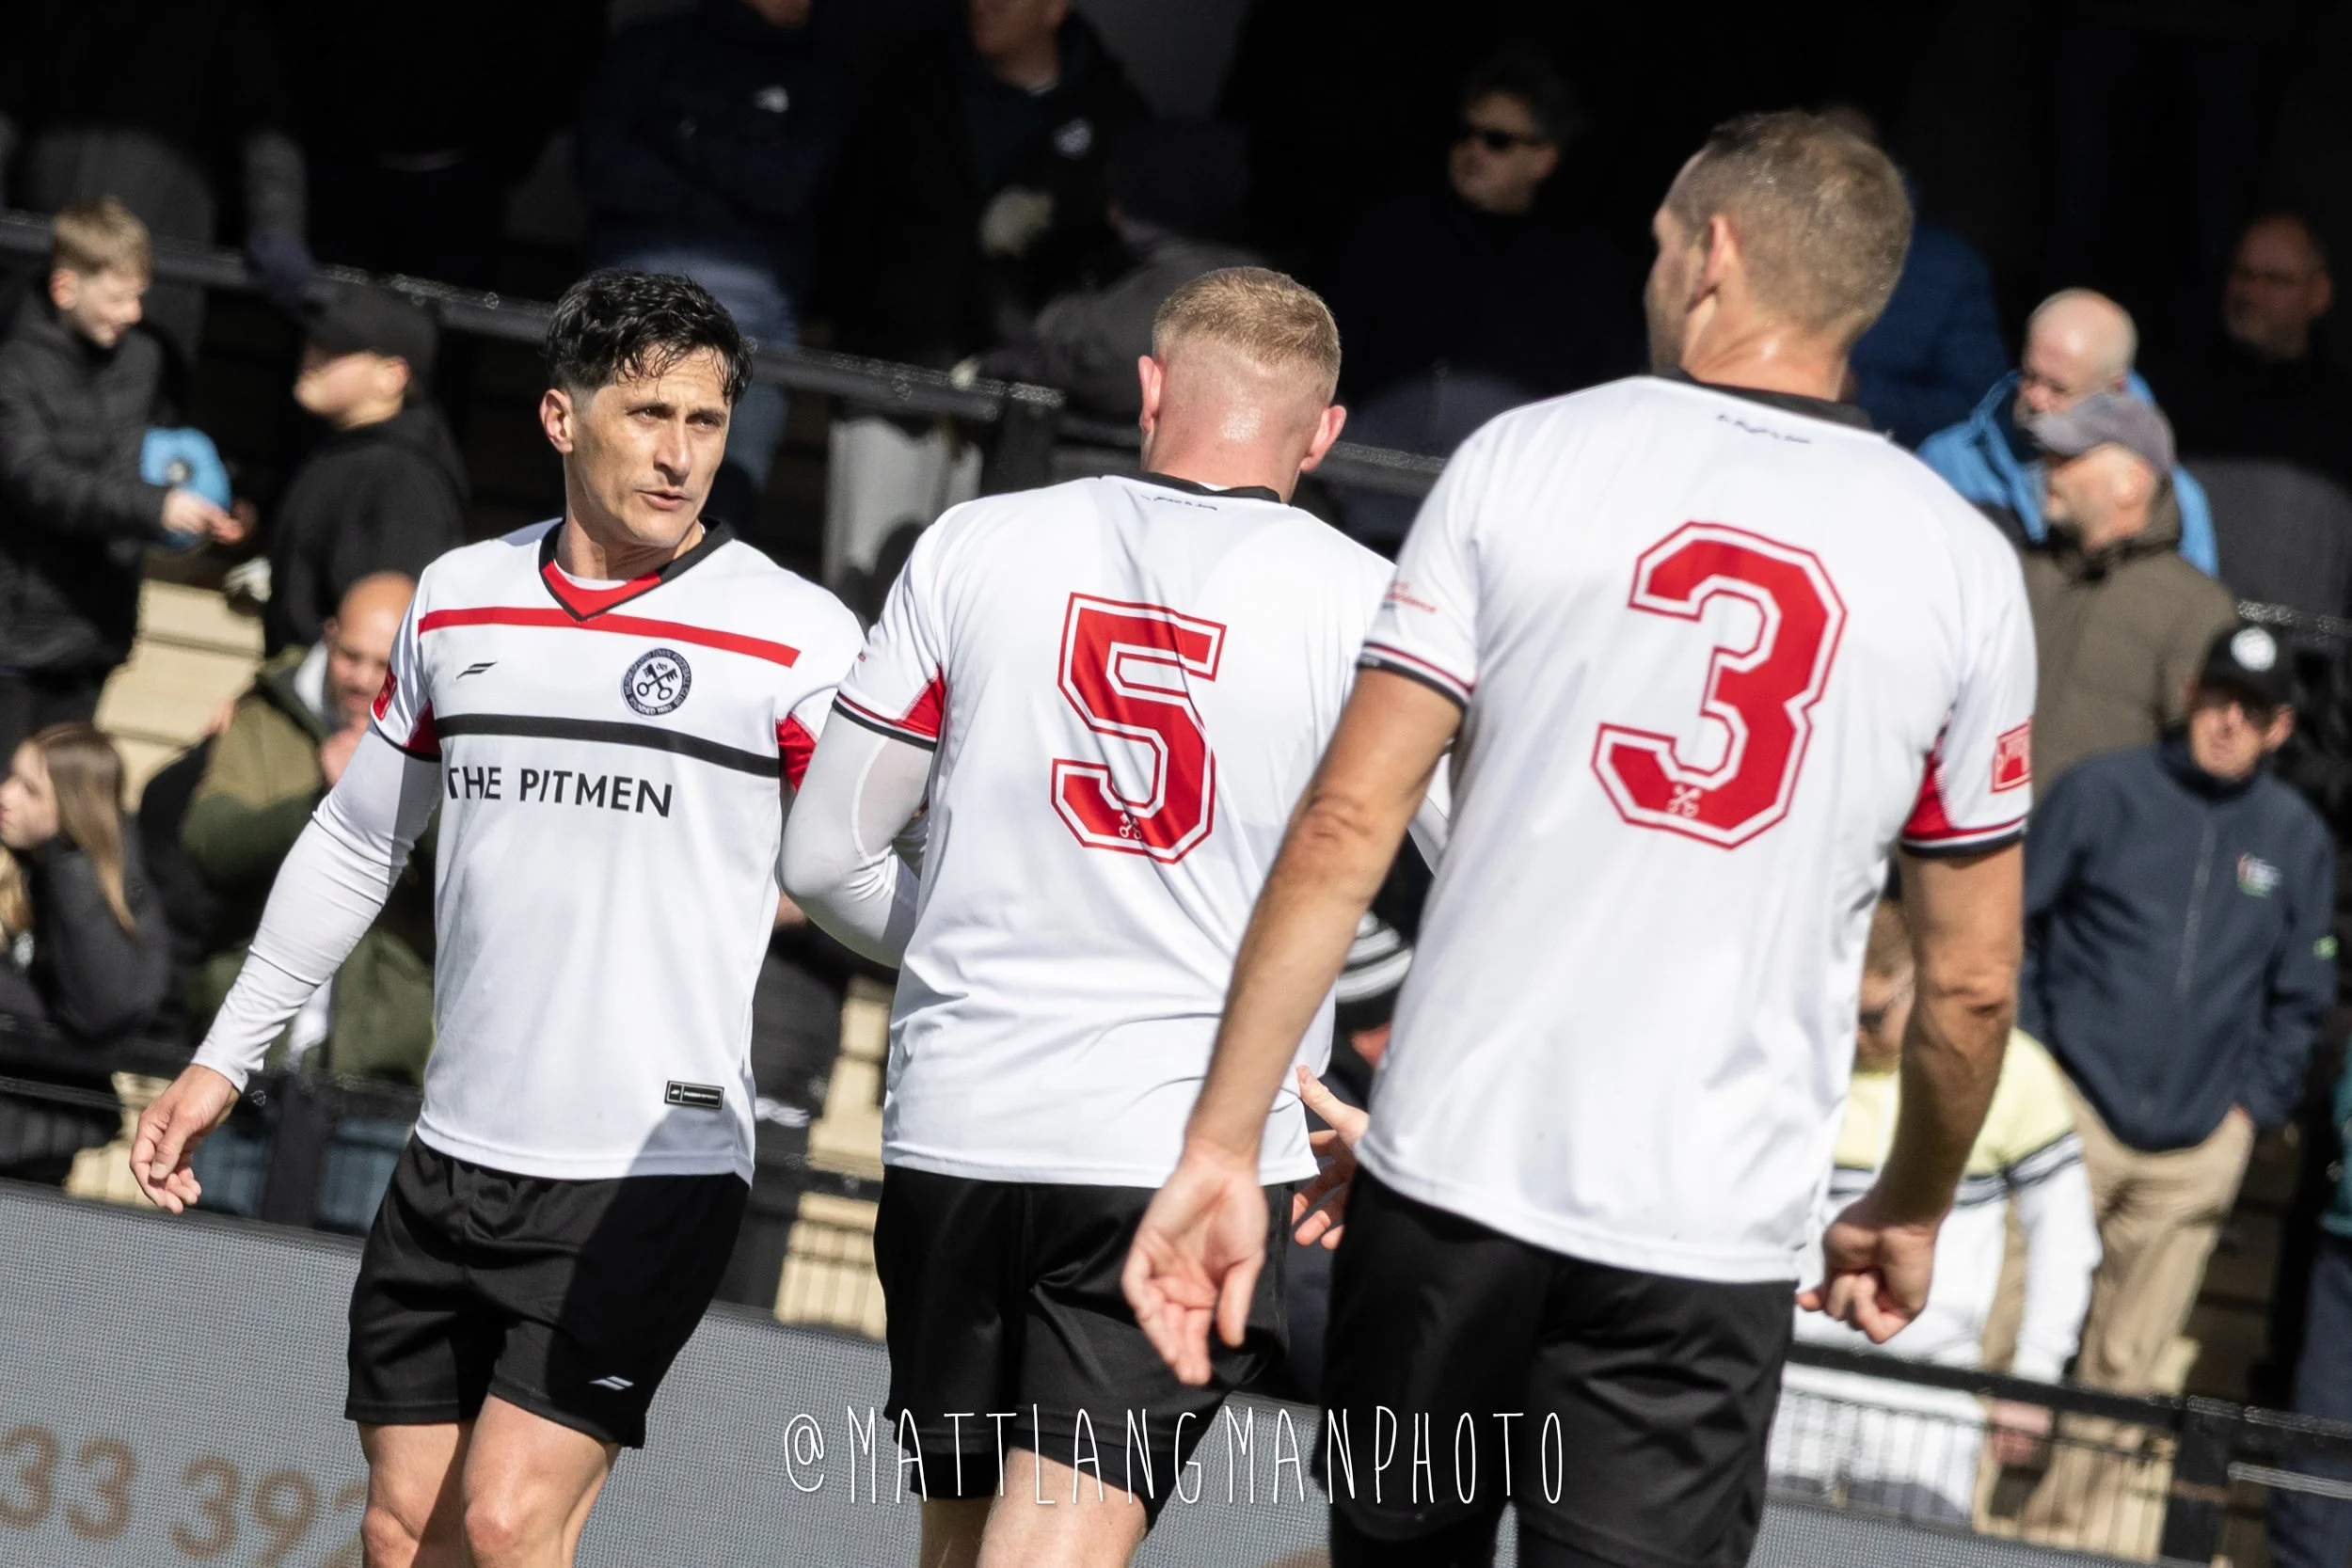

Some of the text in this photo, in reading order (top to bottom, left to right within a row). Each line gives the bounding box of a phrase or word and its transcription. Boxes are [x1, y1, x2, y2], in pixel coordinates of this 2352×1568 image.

[447, 766, 673, 818] THE PITMEN
[1050, 591, 1228, 864] 5
[1590, 520, 1848, 850] 3
